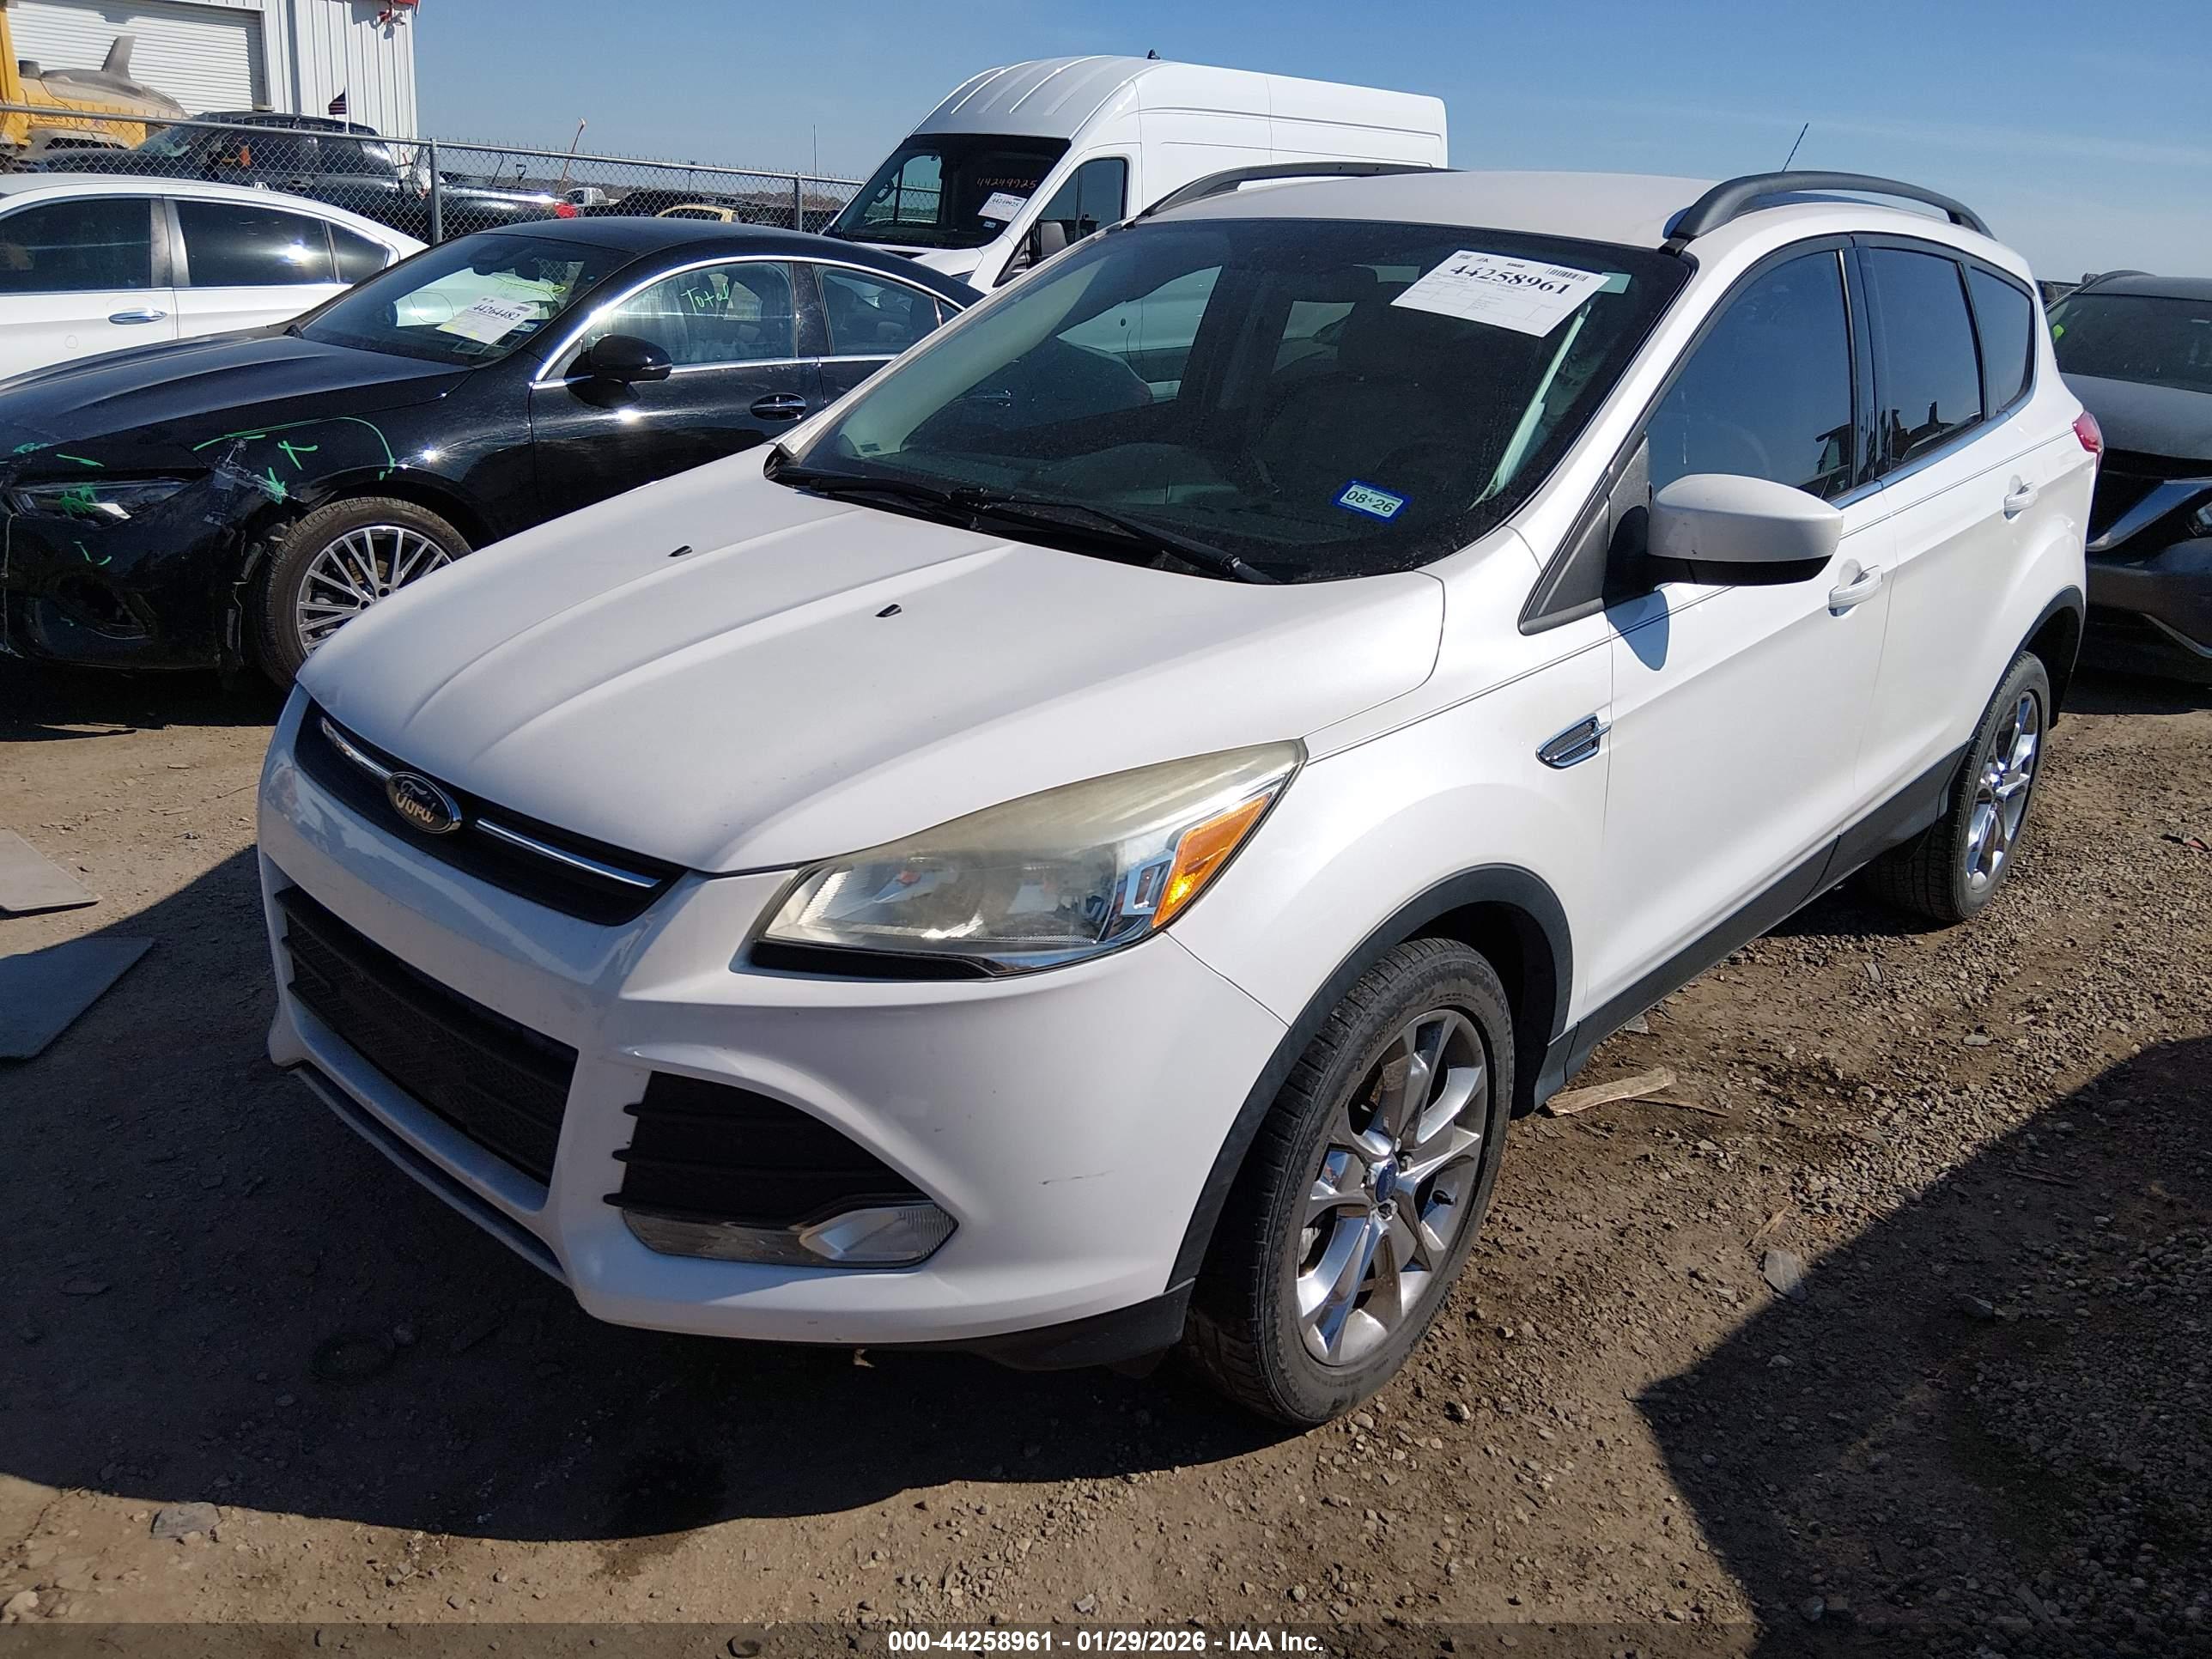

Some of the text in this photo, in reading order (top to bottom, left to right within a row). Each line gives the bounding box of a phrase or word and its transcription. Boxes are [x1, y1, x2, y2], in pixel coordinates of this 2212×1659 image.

[1449, 264, 1571, 295] 44258961
[678, 283, 730, 313] Total
[396, 780, 436, 823] Ford
